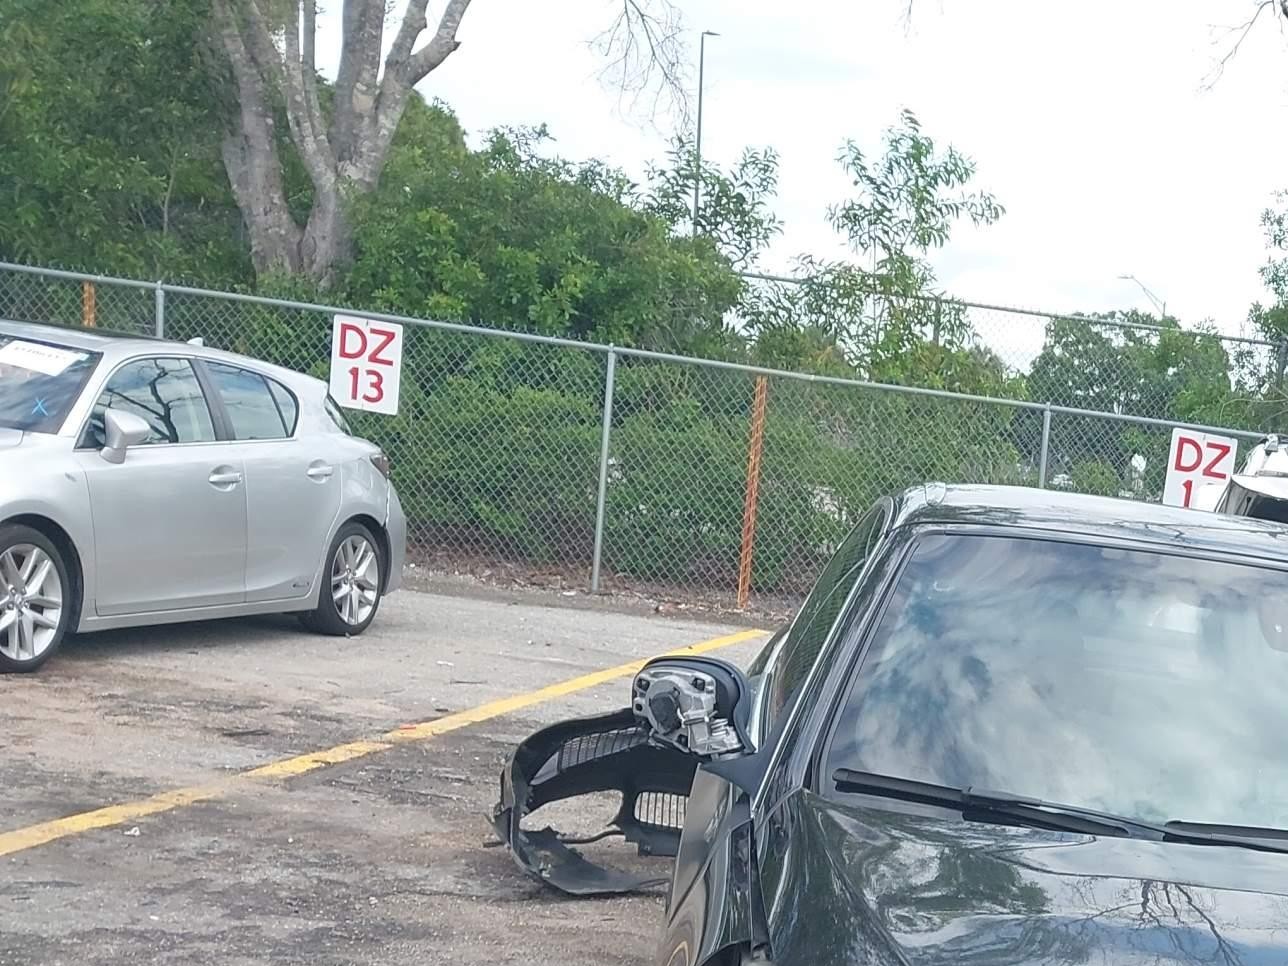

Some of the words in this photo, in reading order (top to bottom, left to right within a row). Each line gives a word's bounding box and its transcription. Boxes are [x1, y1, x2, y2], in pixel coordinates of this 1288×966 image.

[339, 323, 396, 366] DZ
[348, 367, 384, 403] 13
[1175, 437, 1231, 479] DZ
